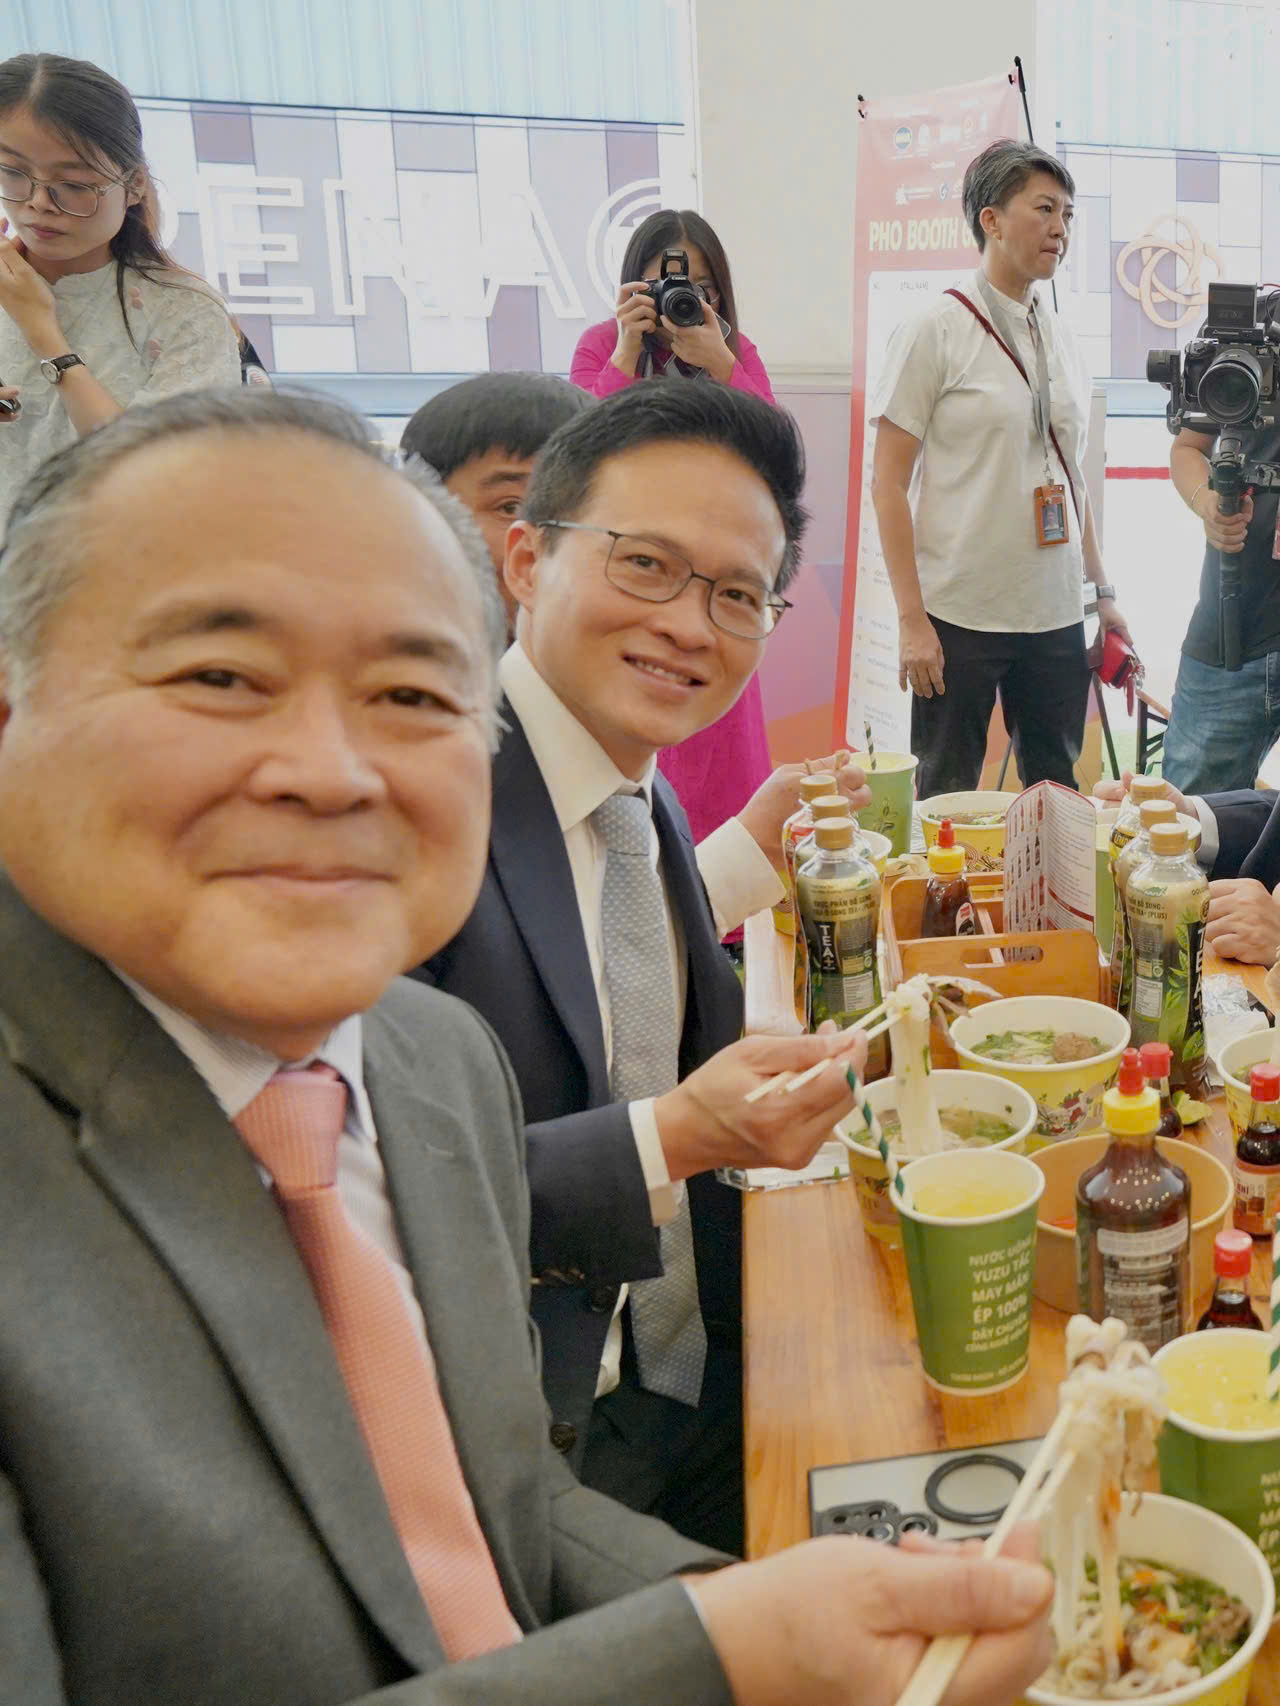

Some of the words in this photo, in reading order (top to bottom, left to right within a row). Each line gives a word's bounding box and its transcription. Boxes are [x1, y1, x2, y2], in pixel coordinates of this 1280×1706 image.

[869, 221, 902, 251] PHO
[907, 217, 959, 250] BOOTH
[973, 1263, 1011, 1284] YUZU
[972, 1284, 1003, 1304] MAY
[973, 1305, 993, 1324] ÉP
